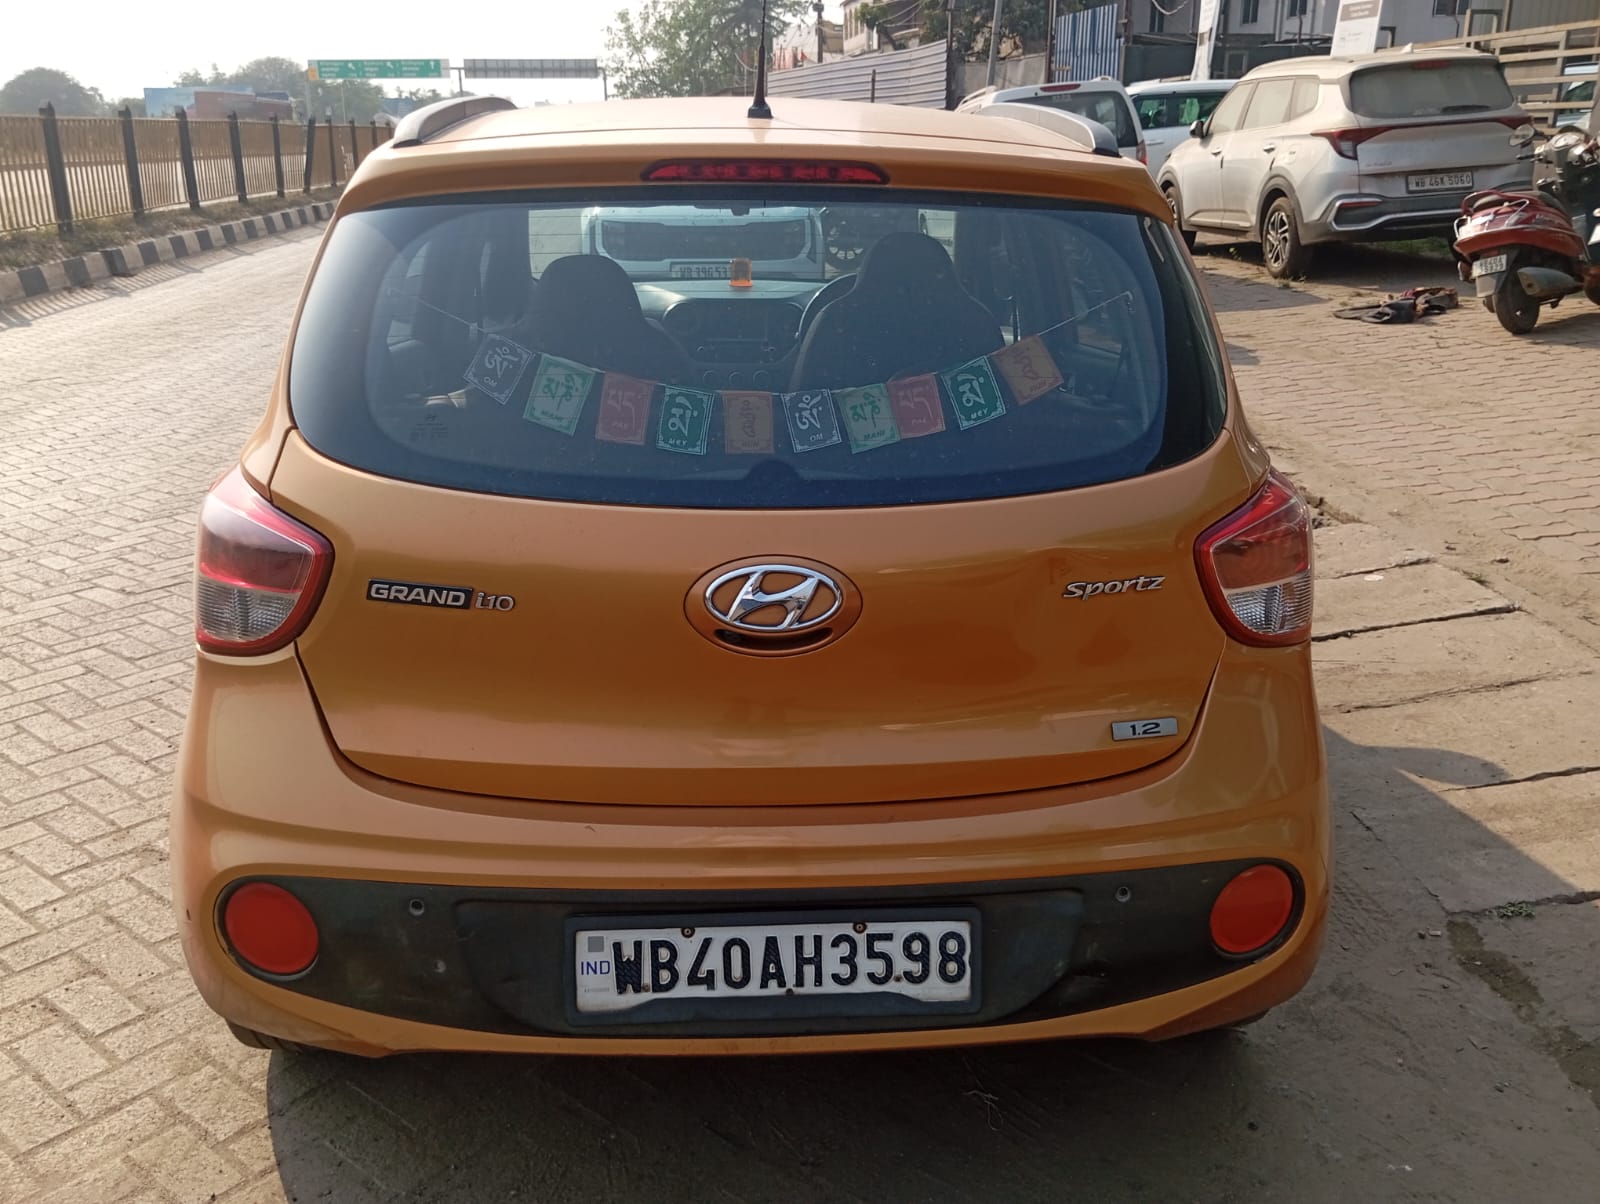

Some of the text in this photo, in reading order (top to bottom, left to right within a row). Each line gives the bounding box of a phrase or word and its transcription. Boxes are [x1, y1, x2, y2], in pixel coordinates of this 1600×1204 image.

[809, 433, 824, 442] OM
[370, 583, 515, 611] GRAND i10
[1063, 575, 1166, 600] Sportz
[1129, 722, 1161, 736] 1.2
[580, 960, 611, 976] IND
[611, 930, 967, 995] WB40AH3598
